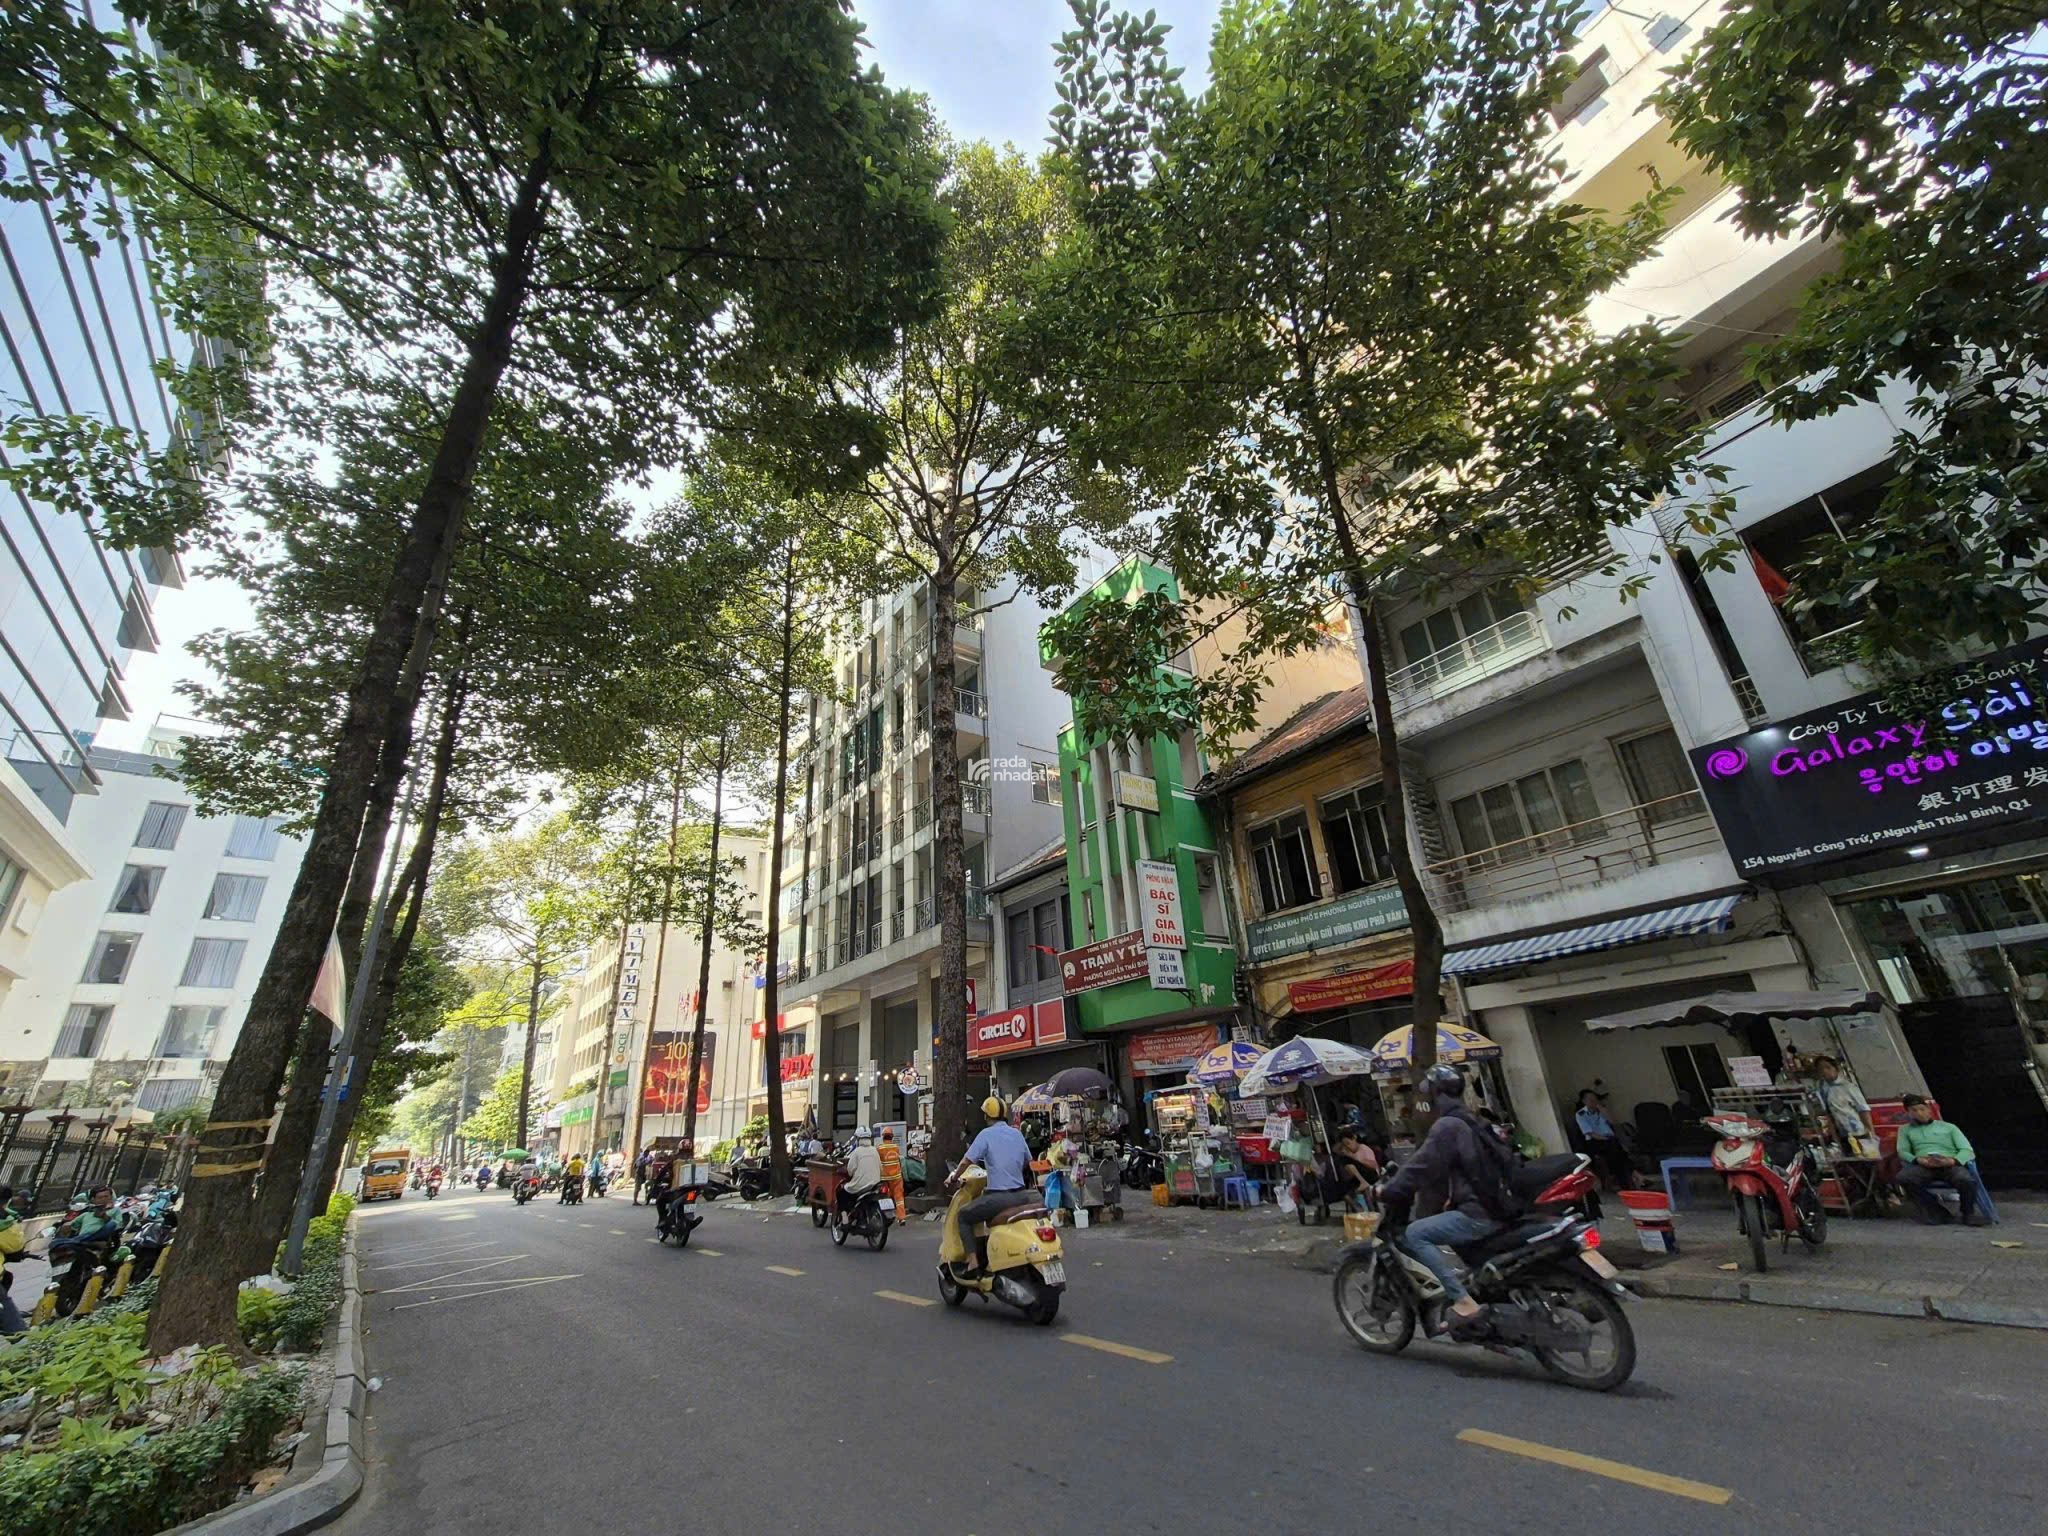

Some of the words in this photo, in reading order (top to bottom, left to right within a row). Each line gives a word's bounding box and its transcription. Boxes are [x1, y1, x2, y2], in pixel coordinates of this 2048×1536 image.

[1789, 721, 1839, 741] Công
[1838, 708, 1868, 725] Ty
[1952, 658, 2038, 690] Beauty
[1770, 719, 1926, 776] Galaxy
[1941, 681, 2031, 731] Sài
[1743, 855, 1766, 870] 154
[1767, 846, 1812, 865] Nguyễn
[1814, 838, 1845, 855] Công
[1936, 812, 1969, 828] Thái
[1150, 887, 1175, 901] BÁC
[1157, 903, 1169, 914] SĨ
[1287, 918, 1300, 928] KHU
[1347, 895, 1376, 911] NGUYỄN
[1155, 919, 1176, 930] GIA
[1352, 918, 1369, 931] KHU
[1152, 931, 1183, 945] ĐÌNH
[1080, 951, 1114, 970] TRẠM
[1116, 947, 1125, 960] Y
[1128, 938, 1146, 957] TẾ
[1083, 971, 1103, 982] PHƯỜNG
[979, 1022, 1011, 1040] CIRCLE
[1012, 1015, 1025, 1037] K
[617, 1033, 627, 1054] OCB
[1167, 1033, 1197, 1043] VITAMIN
[1379, 1040, 1401, 1054] be
[1208, 1054, 1227, 1067] be
[1233, 1051, 1260, 1064] be
[1232, 1103, 1246, 1113] 35K
